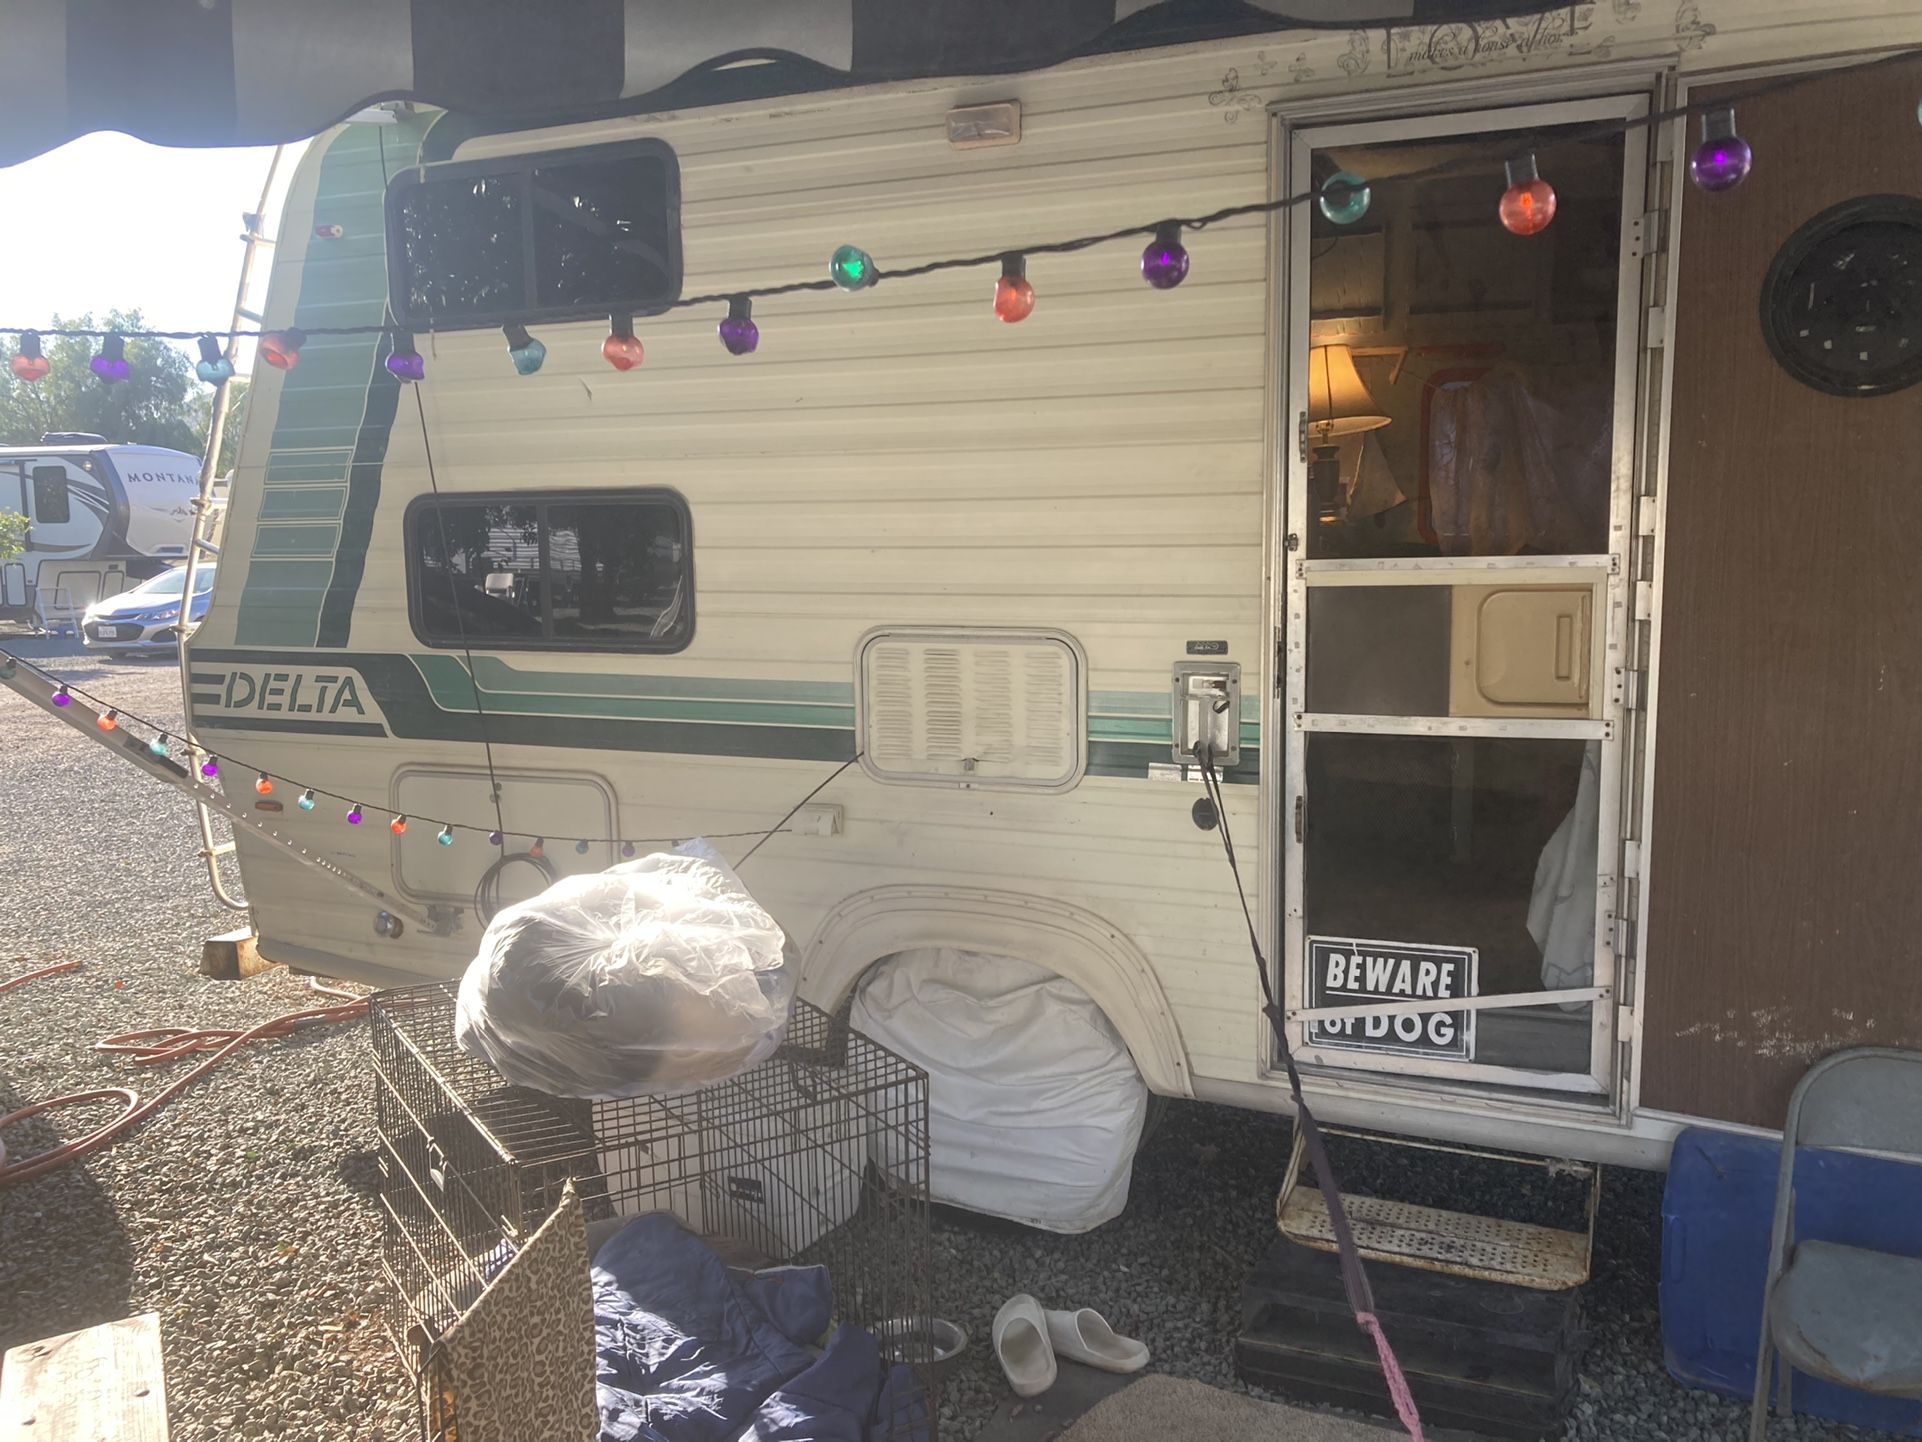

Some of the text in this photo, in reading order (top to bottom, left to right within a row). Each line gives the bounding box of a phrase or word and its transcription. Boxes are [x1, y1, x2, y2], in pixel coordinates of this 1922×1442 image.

[127, 472, 200, 486] MONTAN
[224, 671, 365, 715] DELTA
[1326, 953, 1455, 999] BEWARE
[1365, 1011, 1455, 1046] DOG
